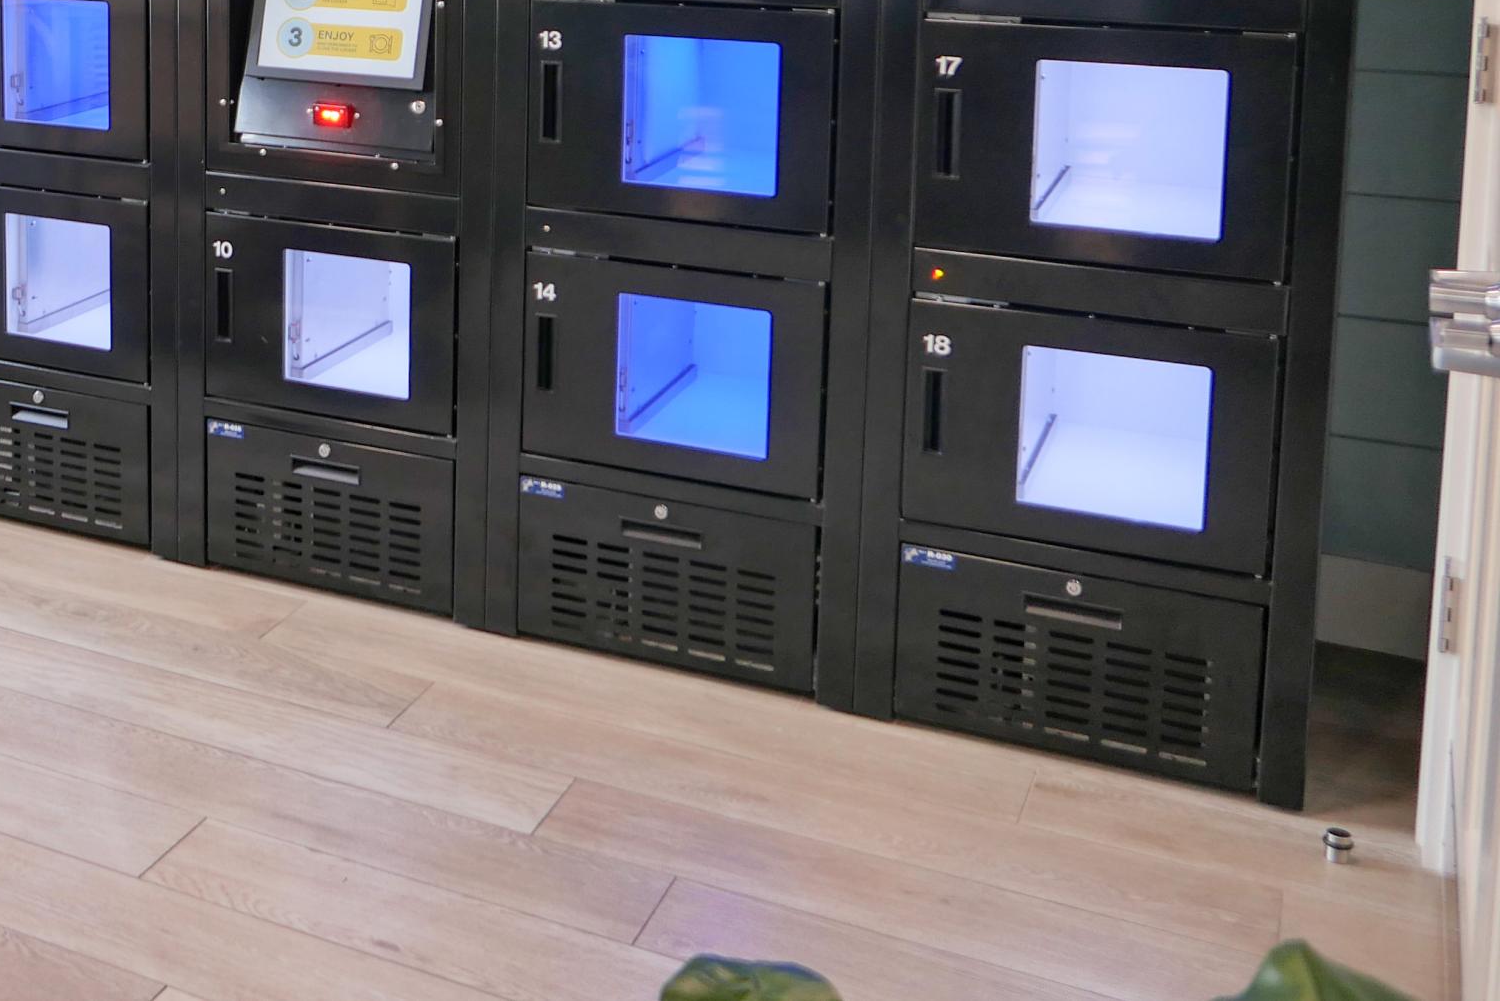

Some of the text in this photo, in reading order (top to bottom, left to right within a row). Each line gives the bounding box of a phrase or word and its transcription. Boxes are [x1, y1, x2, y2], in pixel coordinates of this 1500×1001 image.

[288, 27, 302, 47] 3
[318, 30, 355, 42] ENJOY
[539, 30, 563, 50] 13
[935, 55, 964, 76] 17
[212, 240, 234, 259] 10
[533, 282, 557, 301] 14
[922, 333, 951, 356] 18
